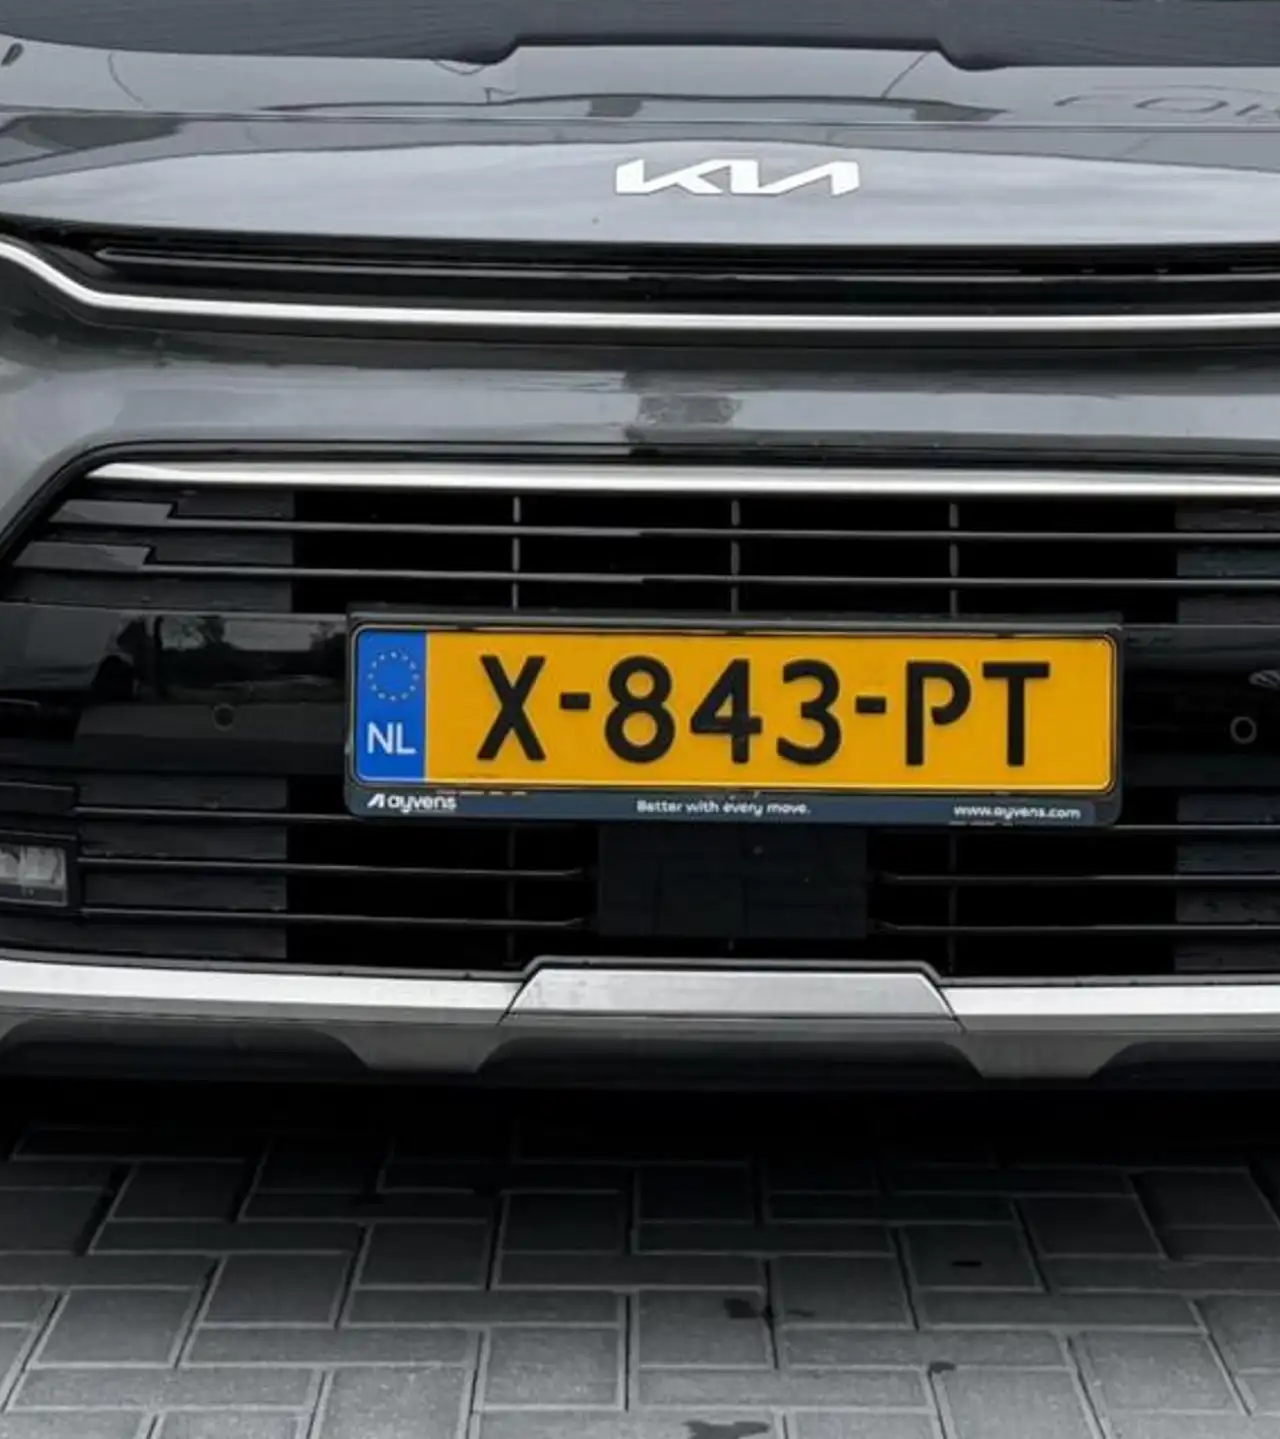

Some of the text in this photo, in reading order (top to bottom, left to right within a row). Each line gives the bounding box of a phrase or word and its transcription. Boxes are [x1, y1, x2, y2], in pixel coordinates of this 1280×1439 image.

[615, 159, 860, 196] KIA
[367, 654, 1051, 767] NL X-843-PT
[636, 799, 683, 814] Better
[685, 798, 720, 814] with
[722, 799, 763, 817] every
[953, 805, 1082, 820] www.ayvens.com
